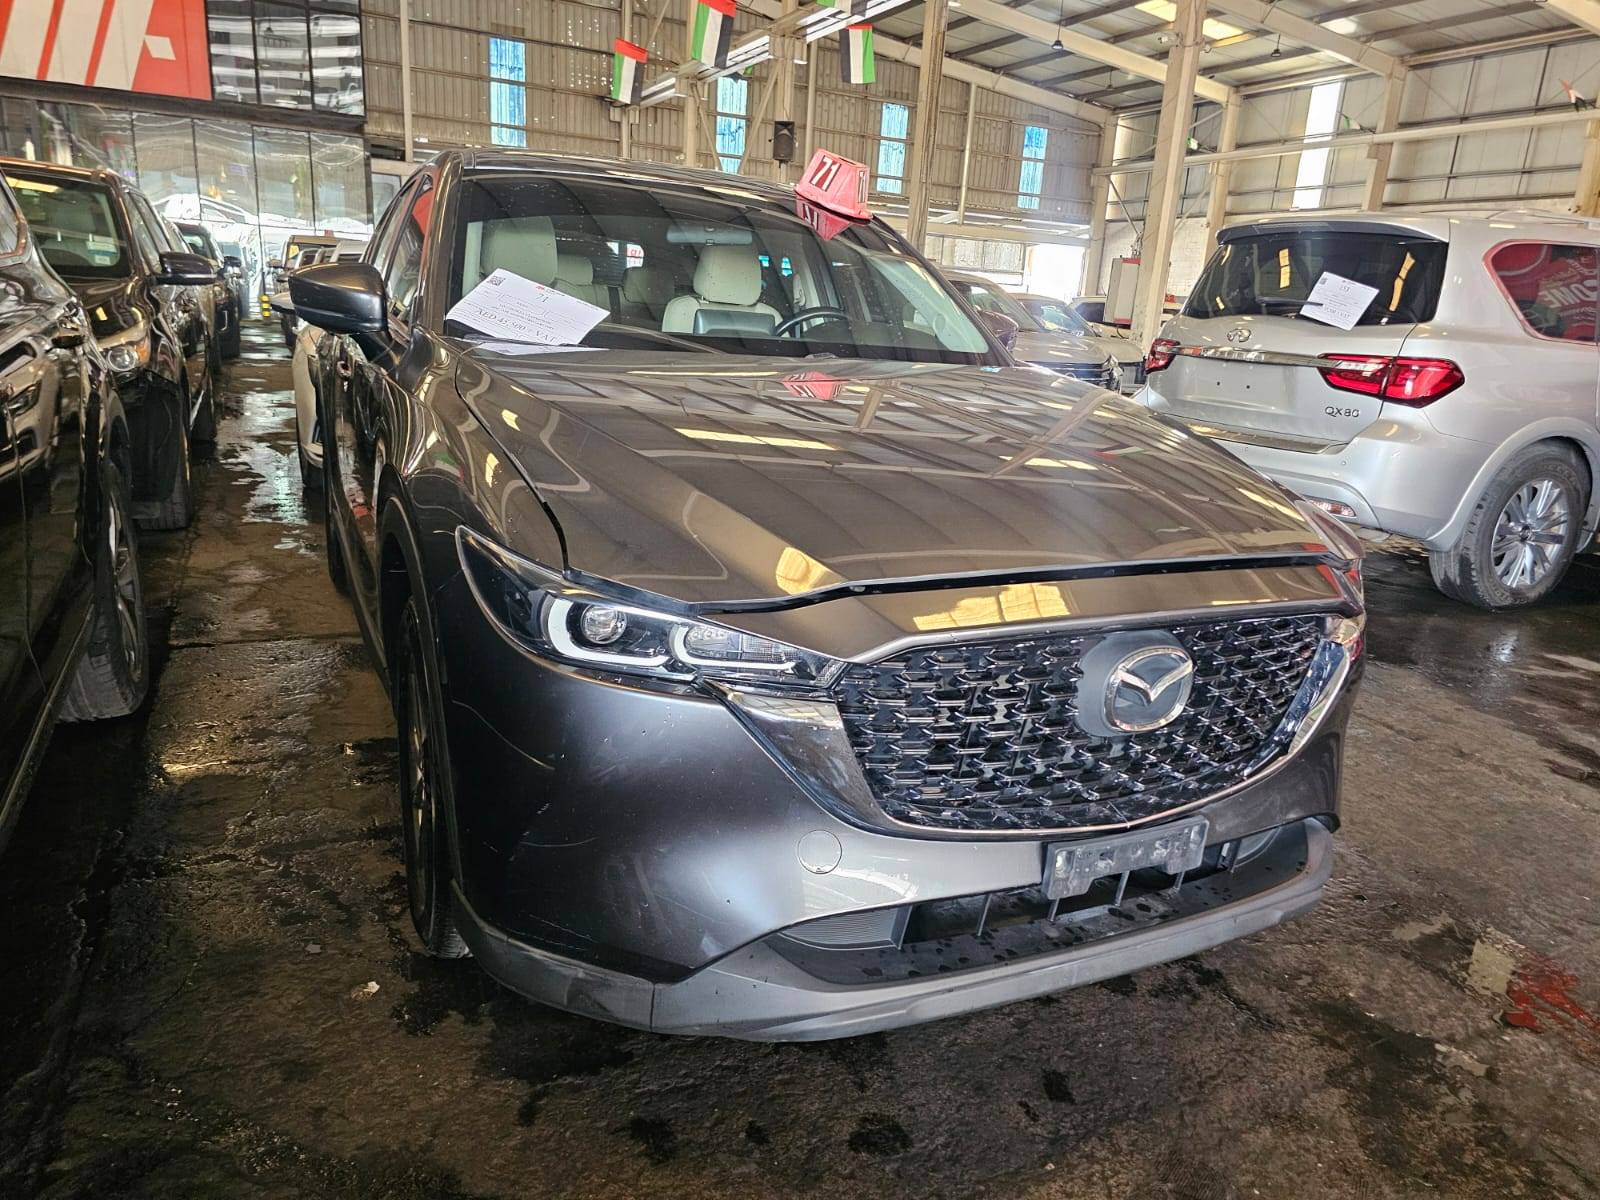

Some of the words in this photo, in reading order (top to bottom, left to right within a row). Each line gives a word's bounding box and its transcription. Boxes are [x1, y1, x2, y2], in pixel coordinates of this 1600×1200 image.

[810, 156, 841, 191] 71
[477, 308, 497, 320] AED
[1325, 406, 1360, 418] QX80
